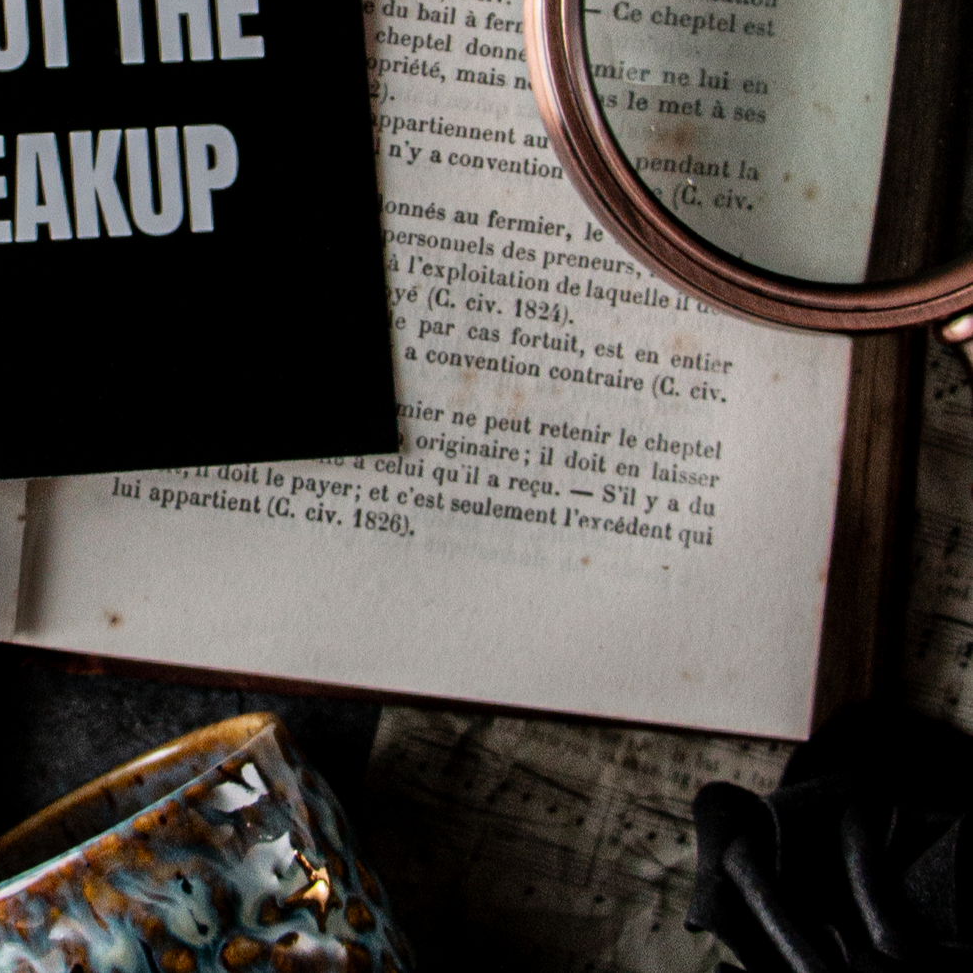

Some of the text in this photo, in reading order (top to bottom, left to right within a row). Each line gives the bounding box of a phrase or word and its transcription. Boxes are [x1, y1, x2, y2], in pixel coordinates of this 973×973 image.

[612, 0, 775, 38] Ce cheptel est
[501, 240, 537, 262] des
[541, 250, 642, 279] preneurs,
[417, 319, 734, 375] par cas fortuit, est en entier
[451, 411, 722, 461] ne peut retenir le cheptel
[111, 477, 416, 538] lui appartient (C. civ. 1826).
[265, 468, 285, 488] le
[368, 484, 389, 503] et
[396, 486, 445, 511] c'est
[449, 496, 557, 527] seulement
[563, 507, 672, 541] l'excédent
[678, 526, 713, 549] qui
